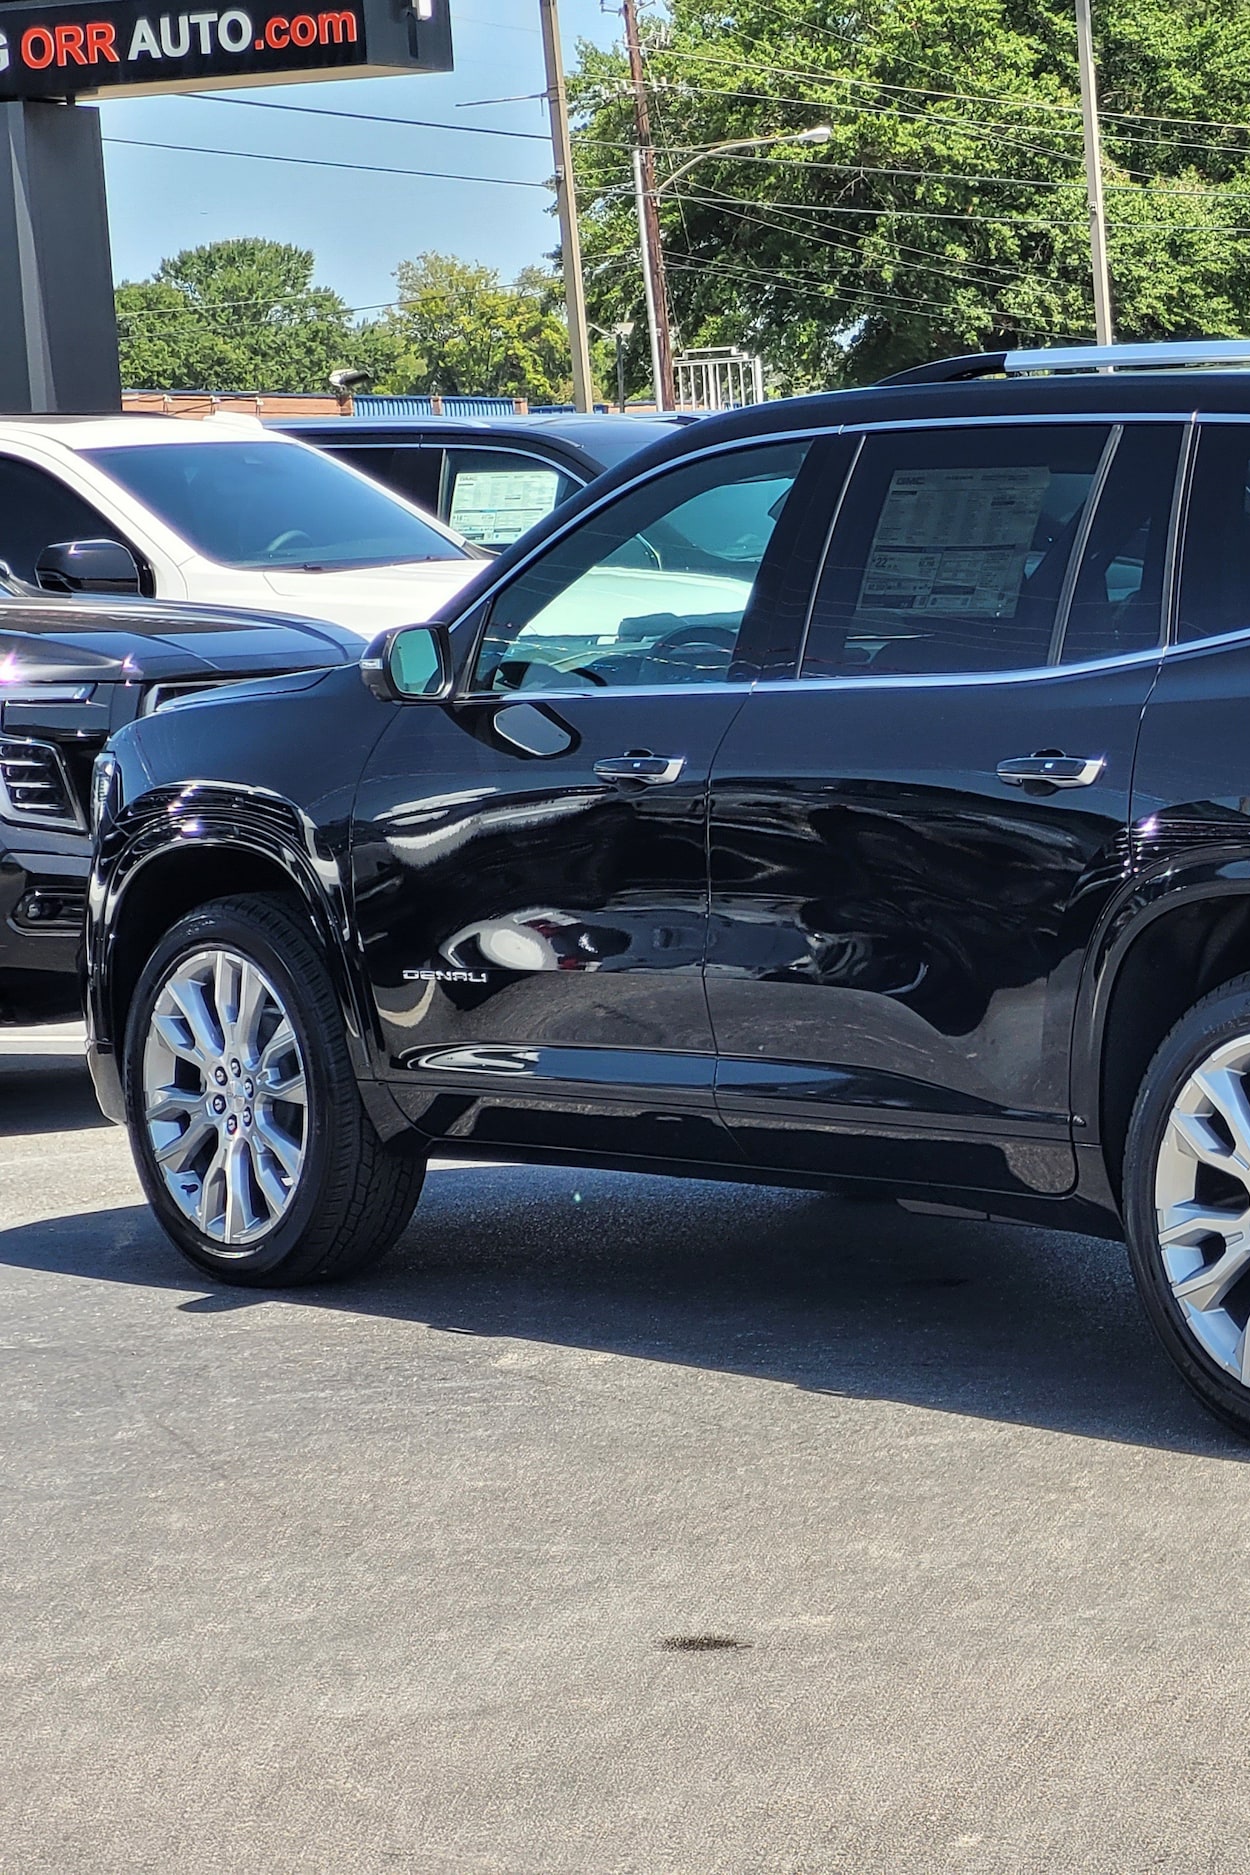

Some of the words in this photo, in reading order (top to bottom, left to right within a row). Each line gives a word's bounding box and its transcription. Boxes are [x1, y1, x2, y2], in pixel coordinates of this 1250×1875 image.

[20, 22, 120, 70] ORR
[127, 10, 358, 61] AUTO.com
[402, 969, 488, 983] DENALI
